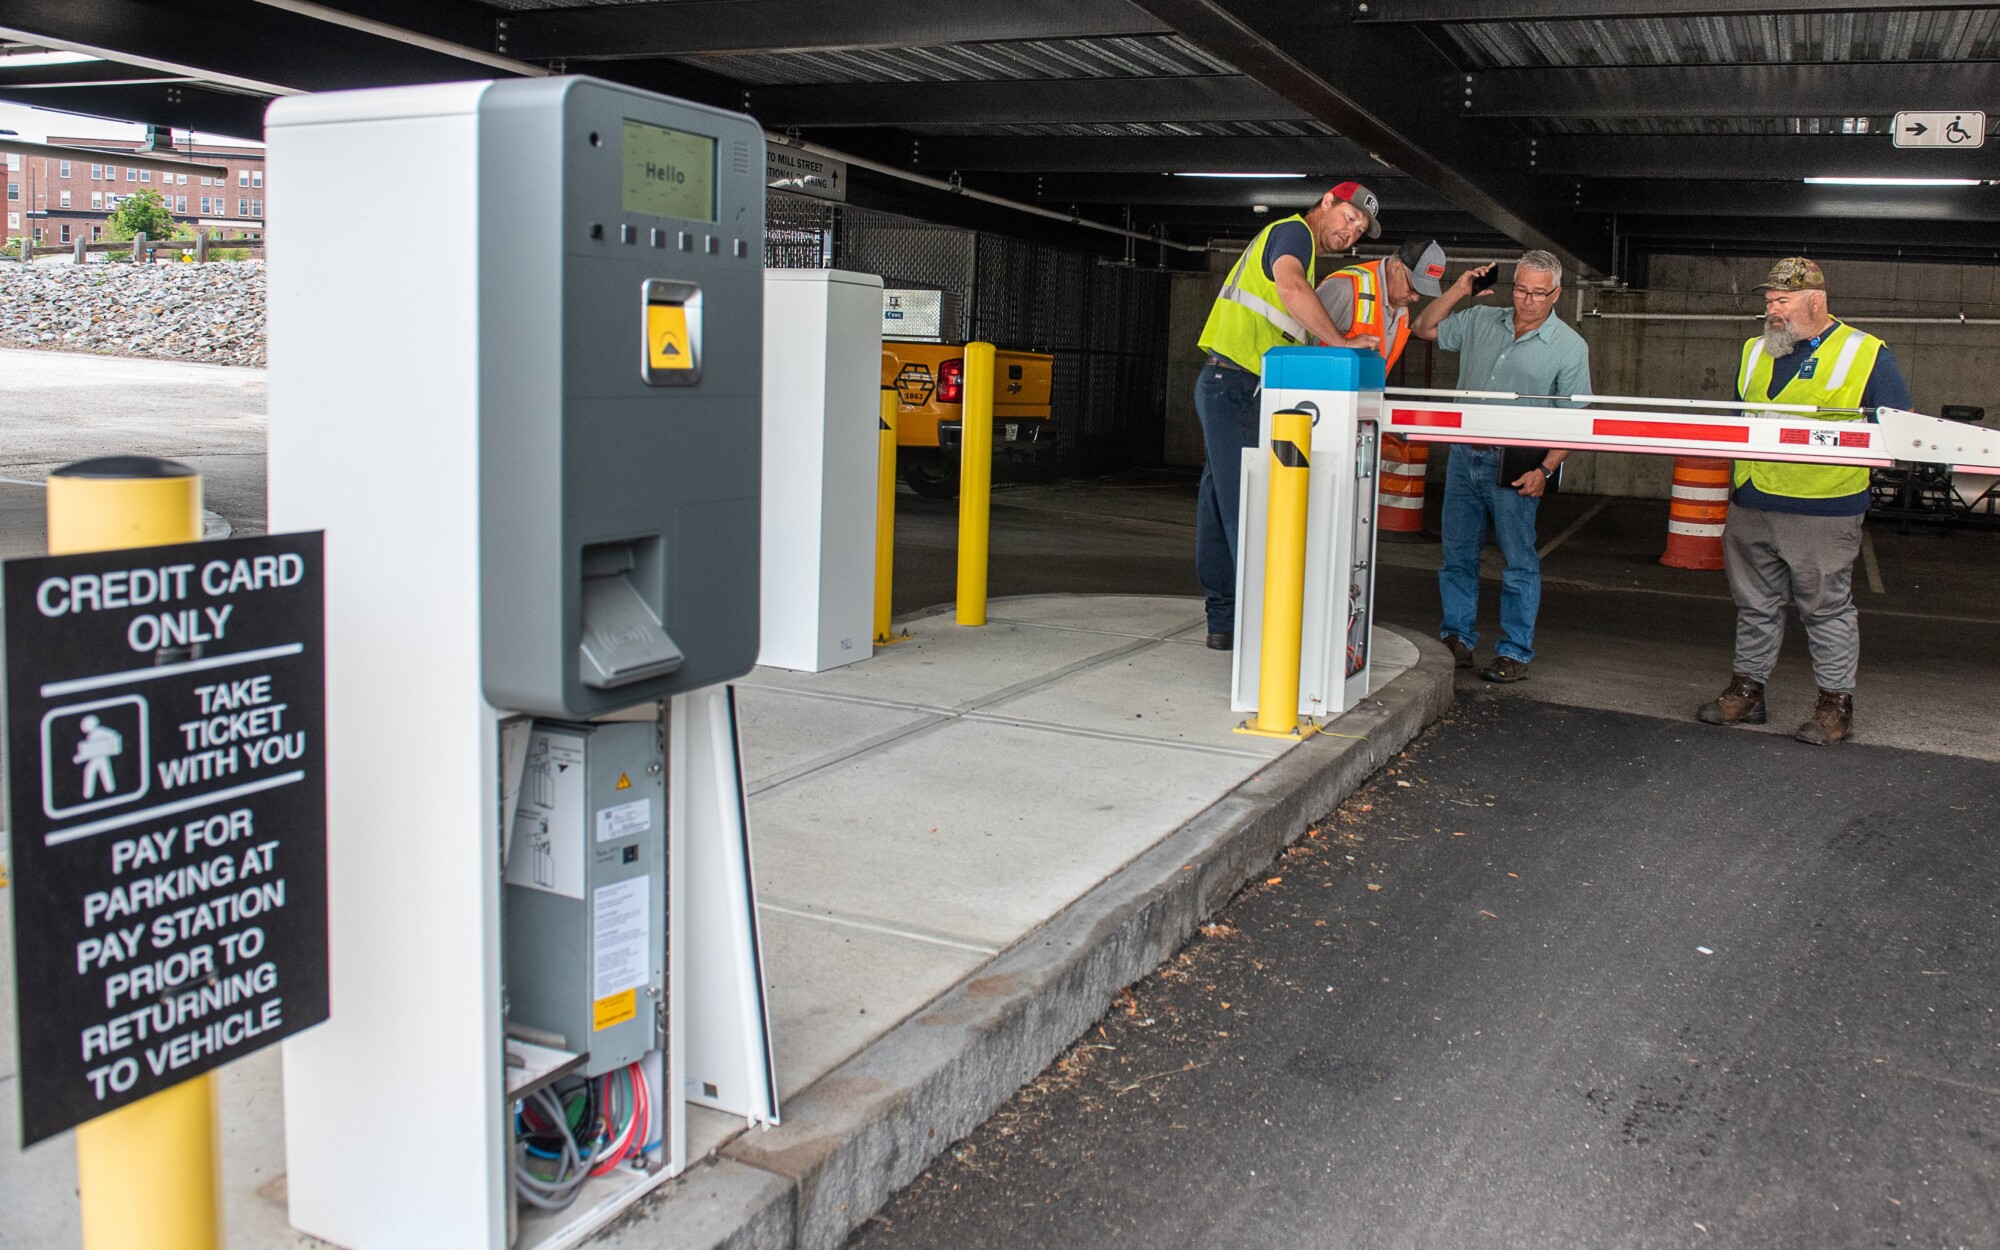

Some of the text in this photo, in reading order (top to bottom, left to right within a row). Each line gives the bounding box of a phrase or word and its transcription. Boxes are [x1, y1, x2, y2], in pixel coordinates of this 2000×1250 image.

[645, 162, 685, 184] Hello
[778, 154, 795, 167] MILL
[797, 159, 823, 173] STREET
[36, 553, 304, 617] CREDIT CARD
[128, 604, 233, 652] ONLY
[194, 675, 272, 714] TAKE
[179, 704, 287, 750] TICKET
[158, 731, 305, 790] WITH YOU
[112, 808, 253, 875] PAY FOR
[84, 840, 280, 928] PARKING AT
[77, 878, 285, 975] PAY STATION
[106, 927, 265, 1009] PRIOR TO
[82, 962, 278, 1062] RETURNING
[86, 998, 283, 1100] TO VEHICLE
